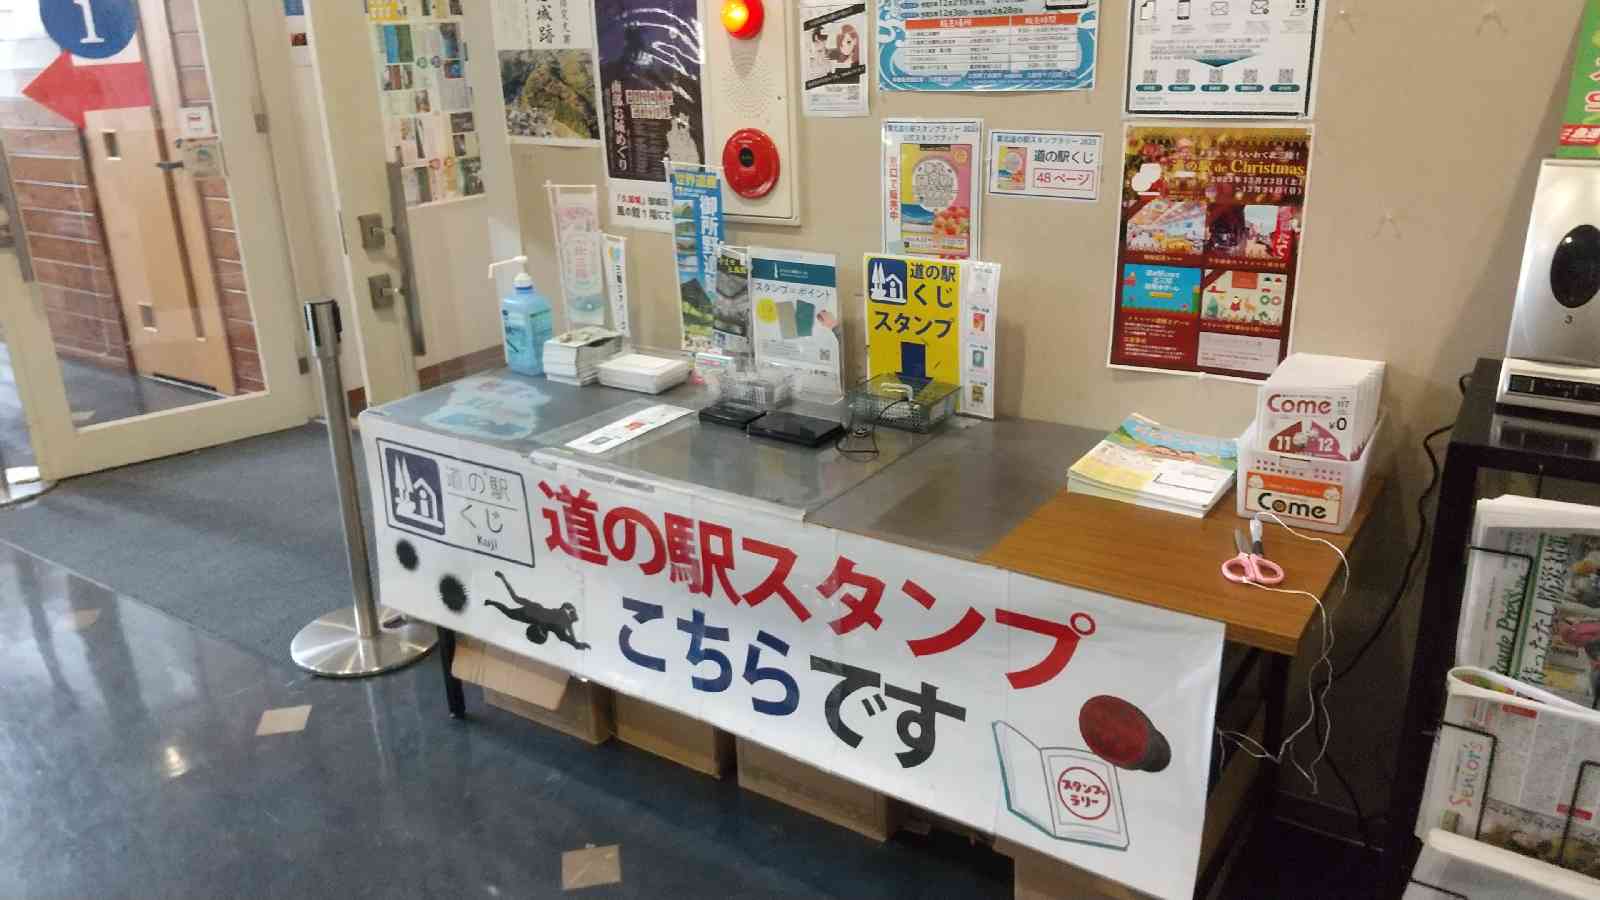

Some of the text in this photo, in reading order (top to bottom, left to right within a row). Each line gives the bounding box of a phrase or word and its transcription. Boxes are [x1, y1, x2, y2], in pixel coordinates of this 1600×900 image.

[1034, 149, 1094, 164] 道の駅くじ
[1231, 159, 1306, 177] Christmas
[909, 261, 957, 283] 道の駅
[912, 283, 954, 309] くじ
[873, 310, 955, 339] スタンプ
[1564, 314, 1573, 325] 3
[1267, 394, 1332, 415] Come
[1276, 436, 1292, 450] 11
[1318, 437, 1334, 452] 12
[446, 465, 512, 502] 道の駅
[1257, 493, 1328, 519] Come
[460, 503, 504, 534] くじ
[537, 478, 1096, 689] 道の駅スタンプ
[618, 596, 967, 769] こちらです
[1062, 779, 1106, 796] スタンプ
[1070, 794, 1099, 808] ラリー
